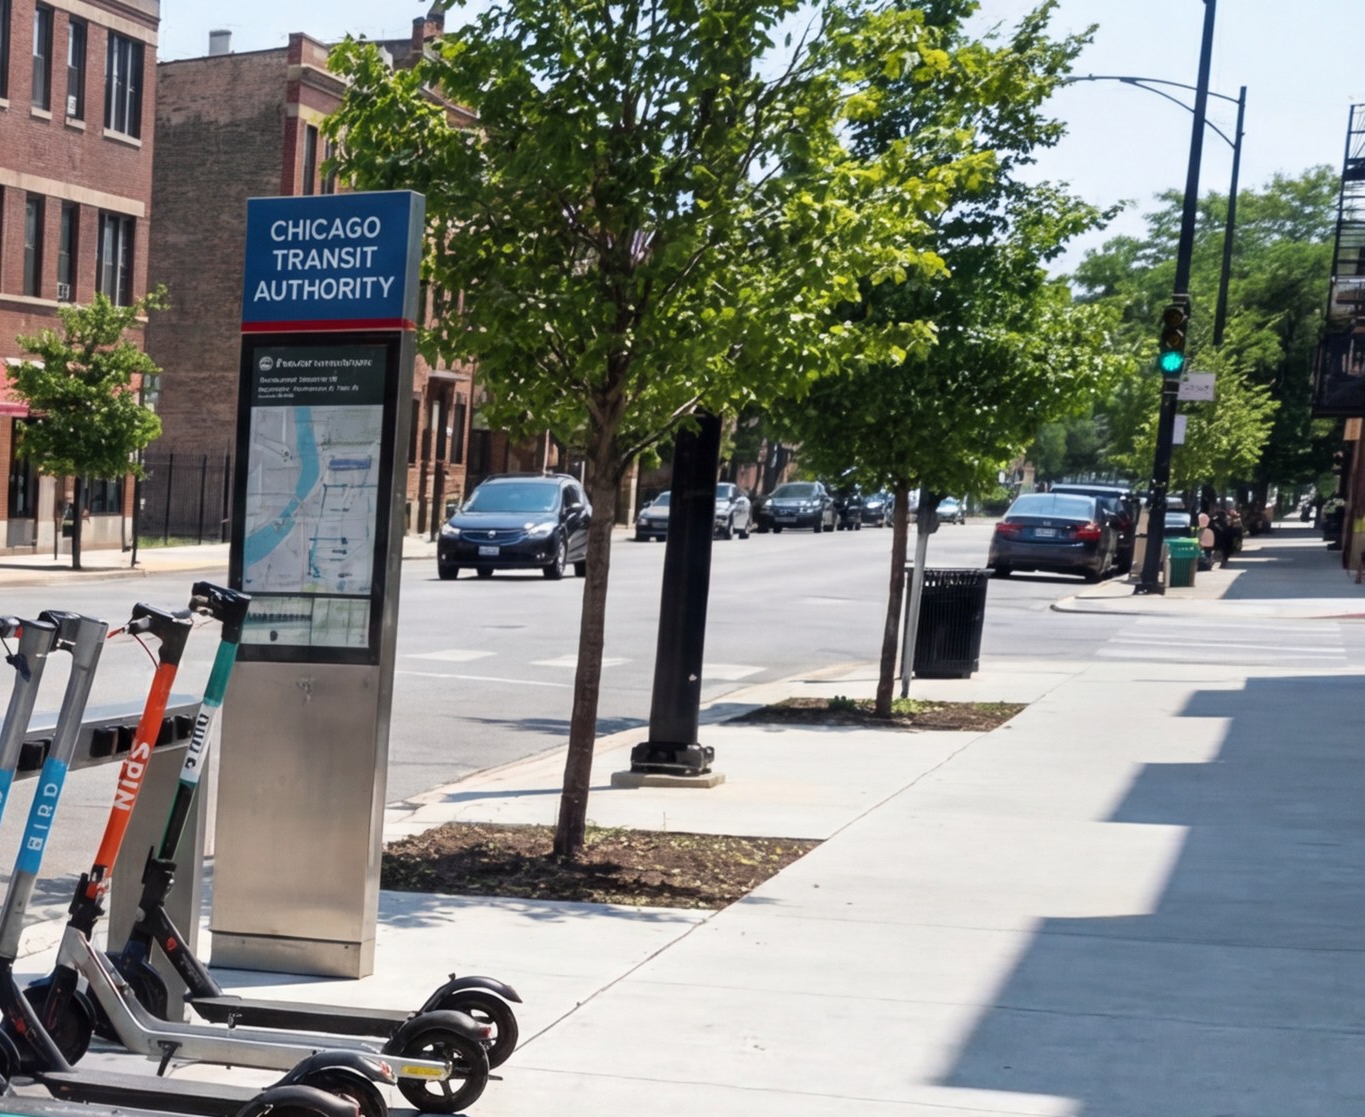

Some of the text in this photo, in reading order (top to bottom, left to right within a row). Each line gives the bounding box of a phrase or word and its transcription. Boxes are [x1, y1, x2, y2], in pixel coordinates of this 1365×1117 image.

[270, 216, 381, 242] CHICAGO
[272, 246, 378, 271] TRANSIT
[253, 276, 395, 302] AUTHORITY
[26, 783, 59, 851] BIRD
